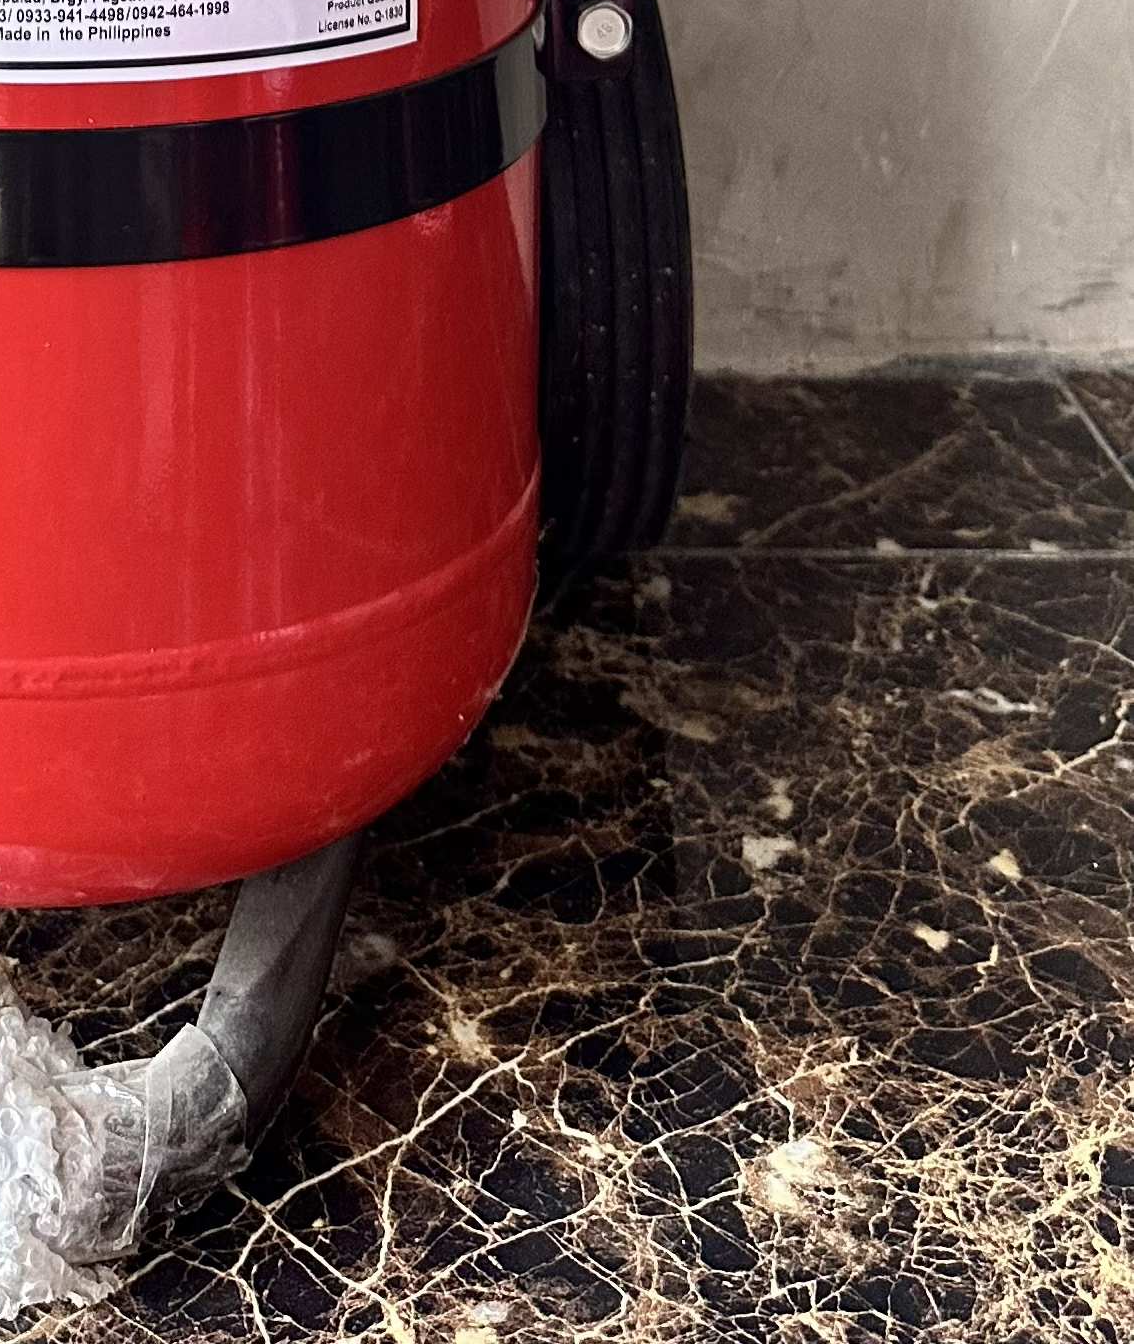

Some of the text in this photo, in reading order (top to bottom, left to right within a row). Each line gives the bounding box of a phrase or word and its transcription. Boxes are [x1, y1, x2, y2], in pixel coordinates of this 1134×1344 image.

[319, 18, 354, 33] License
[358, 14, 371, 26] No.
[37, 27, 49, 41] in
[60, 27, 83, 40] the
[89, 24, 170, 42] Philippines
